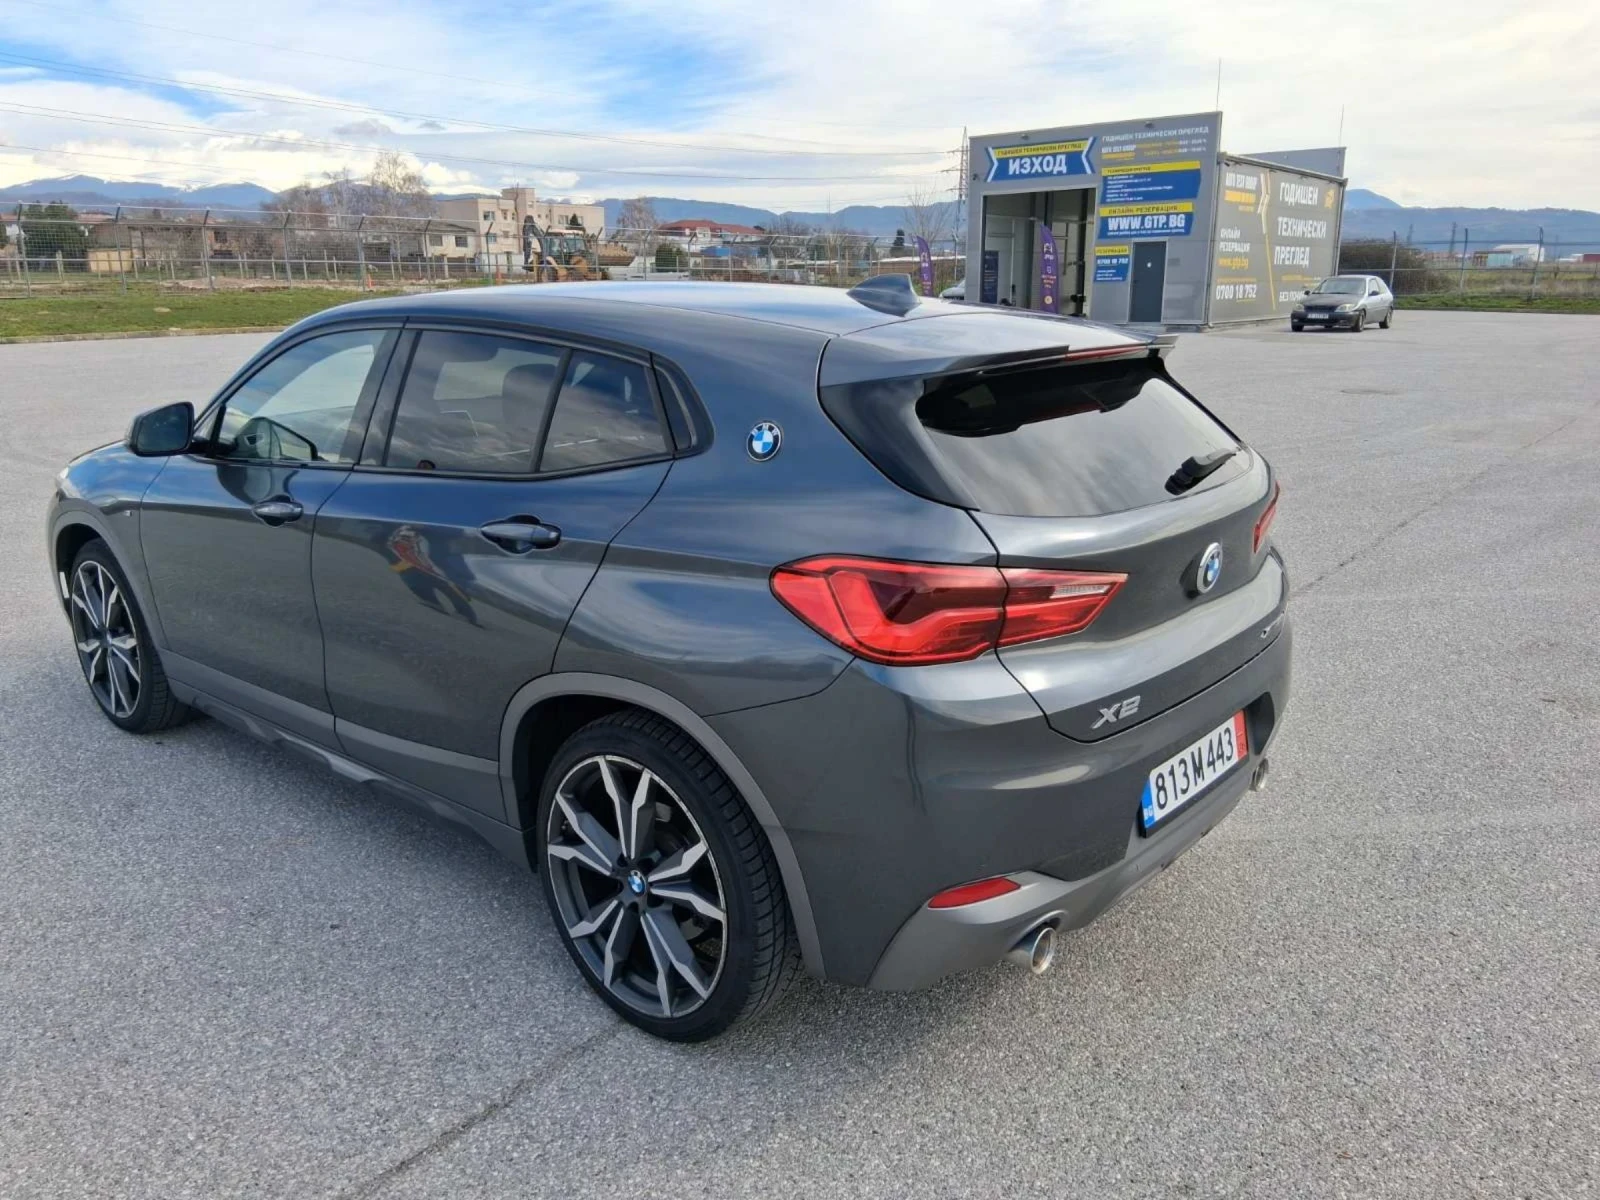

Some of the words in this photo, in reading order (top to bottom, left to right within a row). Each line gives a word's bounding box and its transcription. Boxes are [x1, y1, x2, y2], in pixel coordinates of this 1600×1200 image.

[1008, 154, 1067, 175] ИЗХОД
[1280, 182, 1319, 206] ГОДИШЕН
[1107, 214, 1186, 231] WWW.GTP.BG
[1277, 216, 1327, 239] ТЕХНИЧЕСКИ
[1274, 245, 1310, 268] ПРЕГЛЕД
[1216, 284, 1234, 300] 0700
[1235, 284, 1244, 299] 18
[1243, 283, 1257, 299] 752
[1091, 695, 1141, 729] X2
